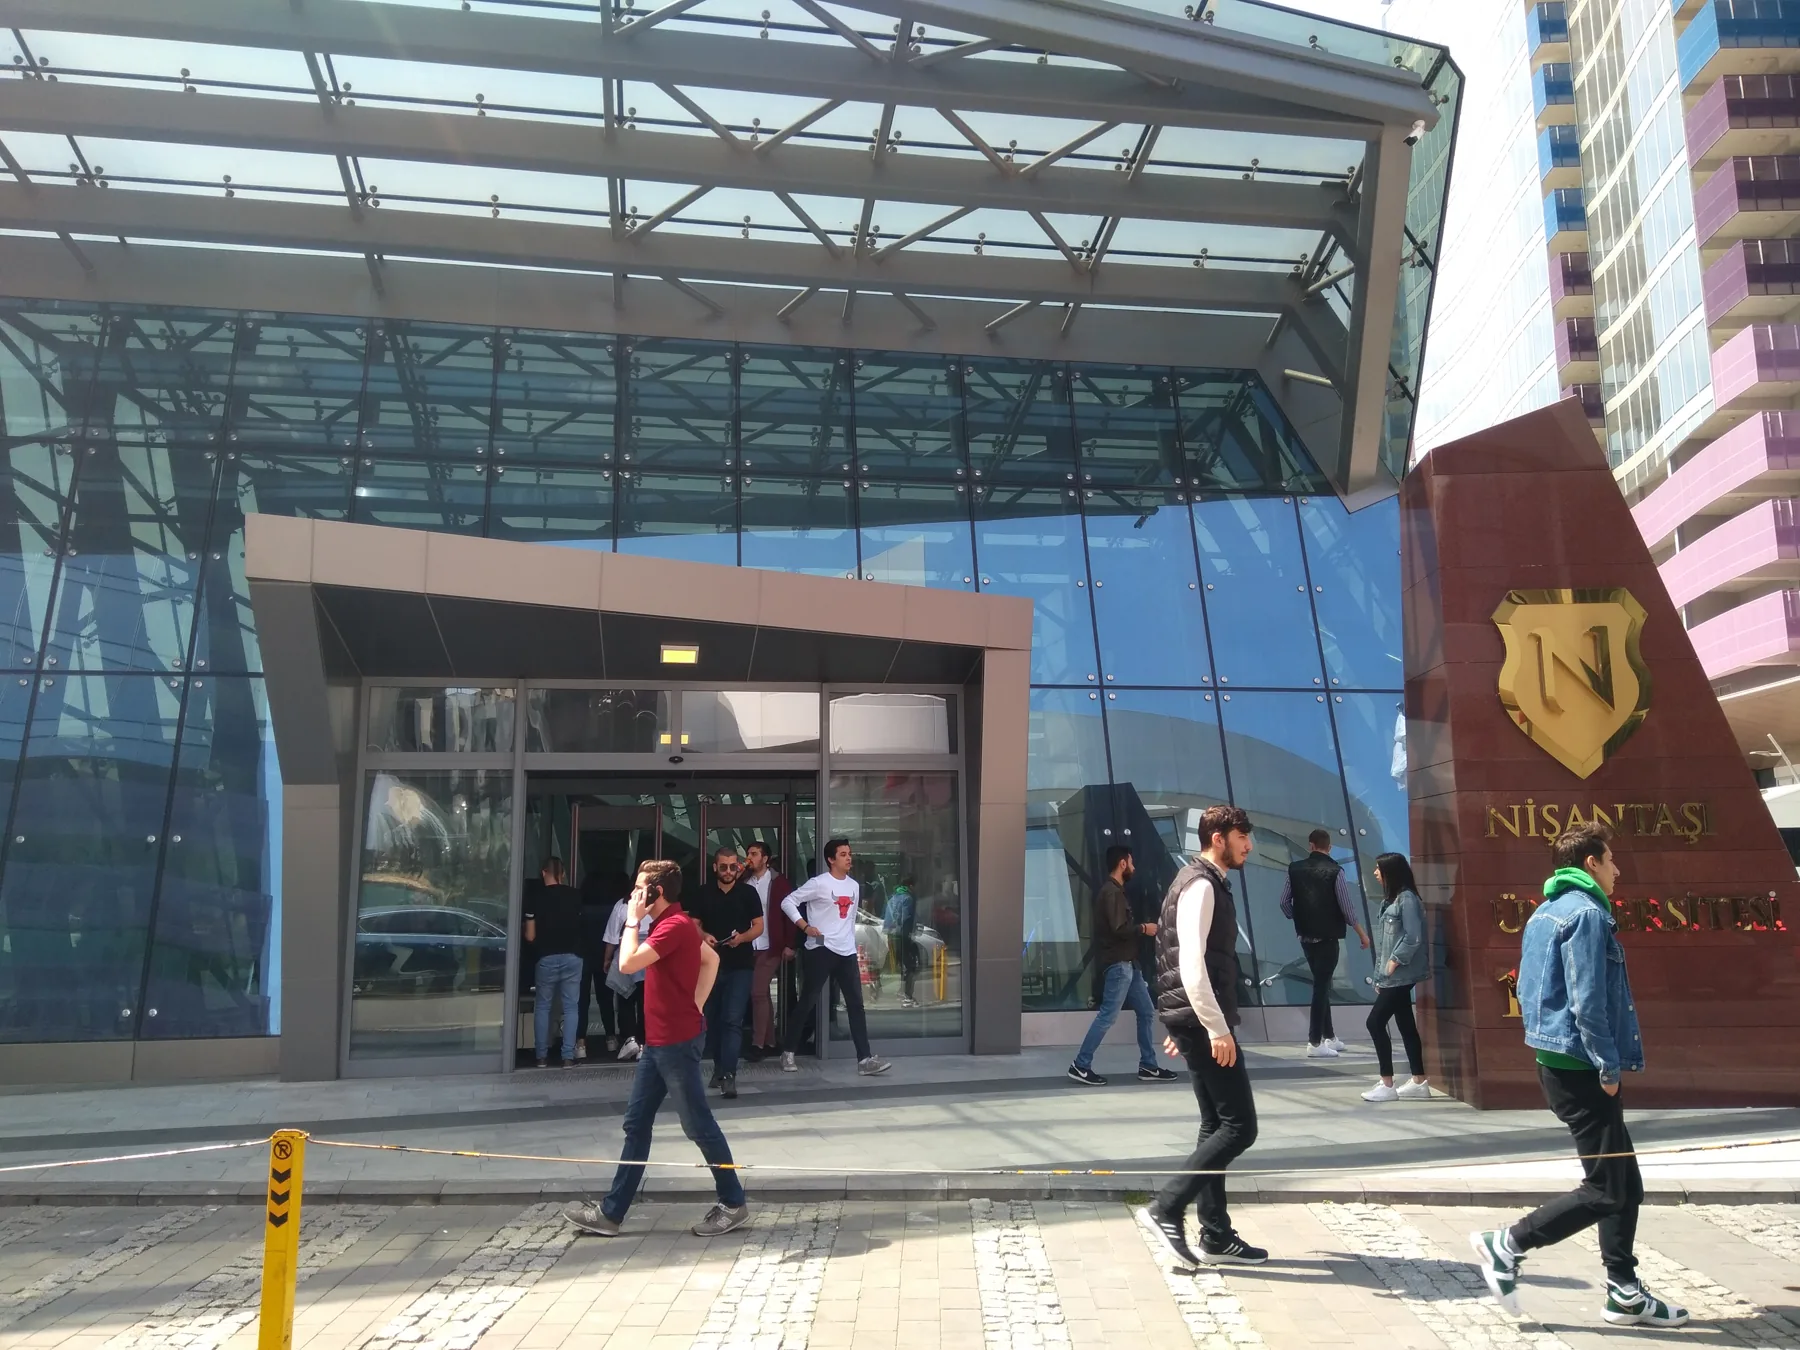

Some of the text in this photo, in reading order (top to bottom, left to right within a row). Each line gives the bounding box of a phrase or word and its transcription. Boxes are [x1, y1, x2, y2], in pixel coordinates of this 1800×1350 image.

[1527, 625, 1615, 715] N
[1485, 798, 1719, 844] NİŞANTAŞI
[1490, 890, 1787, 934] ÜERSİTESİ
